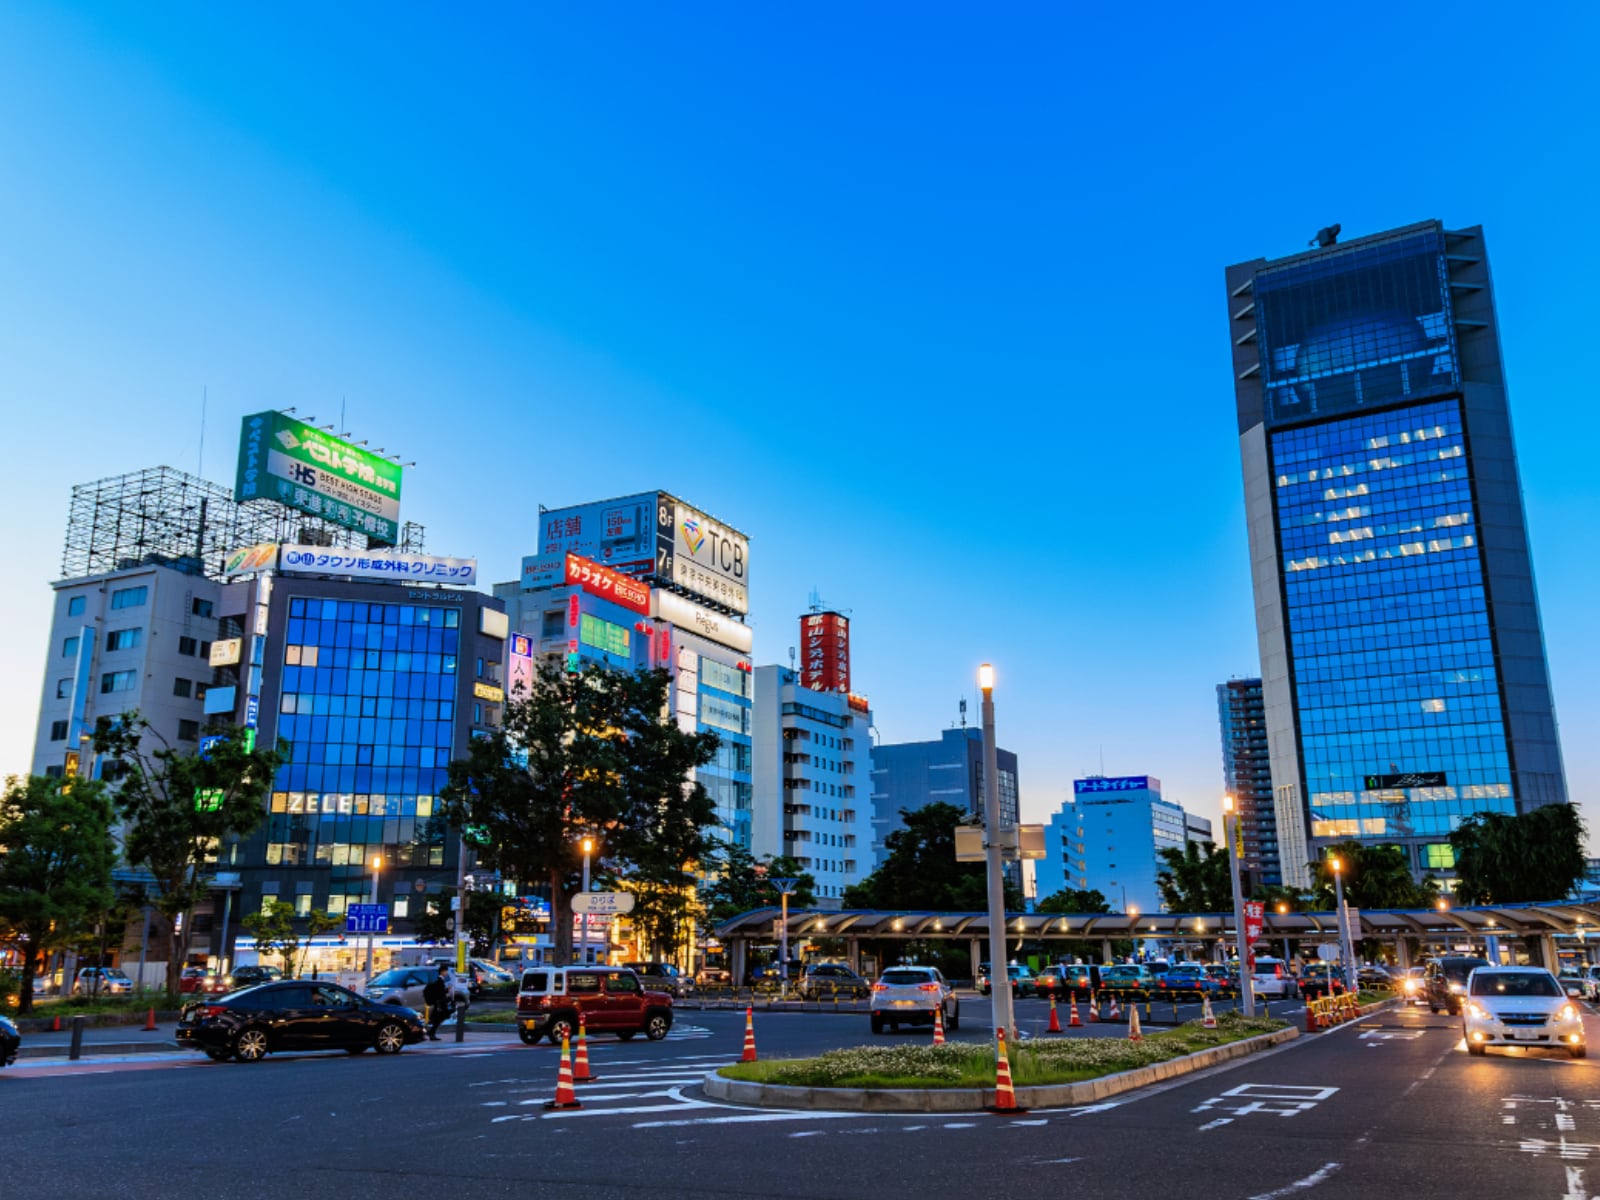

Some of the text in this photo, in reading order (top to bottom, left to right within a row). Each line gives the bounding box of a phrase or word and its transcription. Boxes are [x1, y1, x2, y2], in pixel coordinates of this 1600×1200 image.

[320, 472, 383, 504] BEST HIGH STAGE
[658, 506, 673, 527] 8F
[658, 547, 673, 569] 7F
[708, 529, 744, 578] TCB
[569, 560, 613, 590] カラオケ
[289, 794, 352, 814] ZELE
